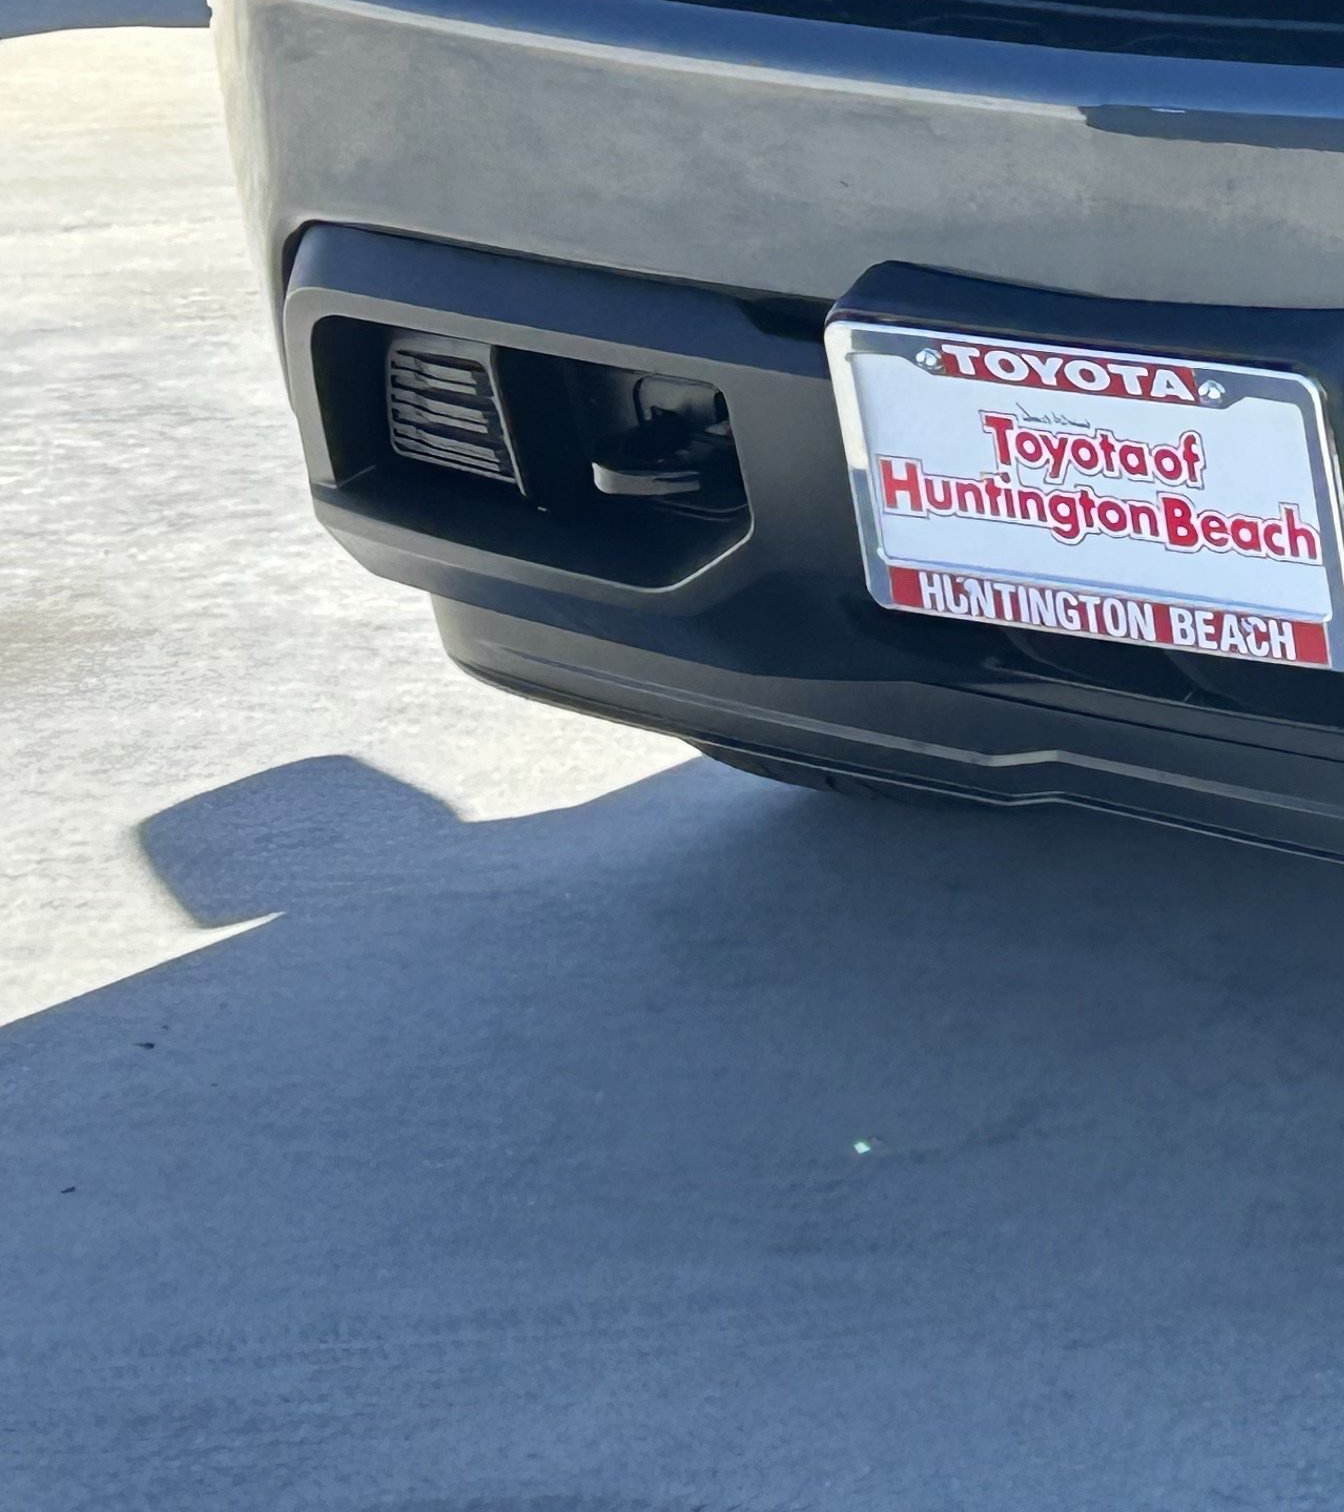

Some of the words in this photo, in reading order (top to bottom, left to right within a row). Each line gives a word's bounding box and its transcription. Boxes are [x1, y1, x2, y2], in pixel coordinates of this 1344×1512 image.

[941, 344, 1195, 401] TOYOTA
[983, 414, 1148, 479] Toyota
[1154, 434, 1202, 483] of
[880, 459, 1160, 538] Huntington
[1161, 496, 1318, 560] Beach
[918, 571, 1156, 642] HUNTINGTON
[1169, 608, 1298, 661] BEACH
